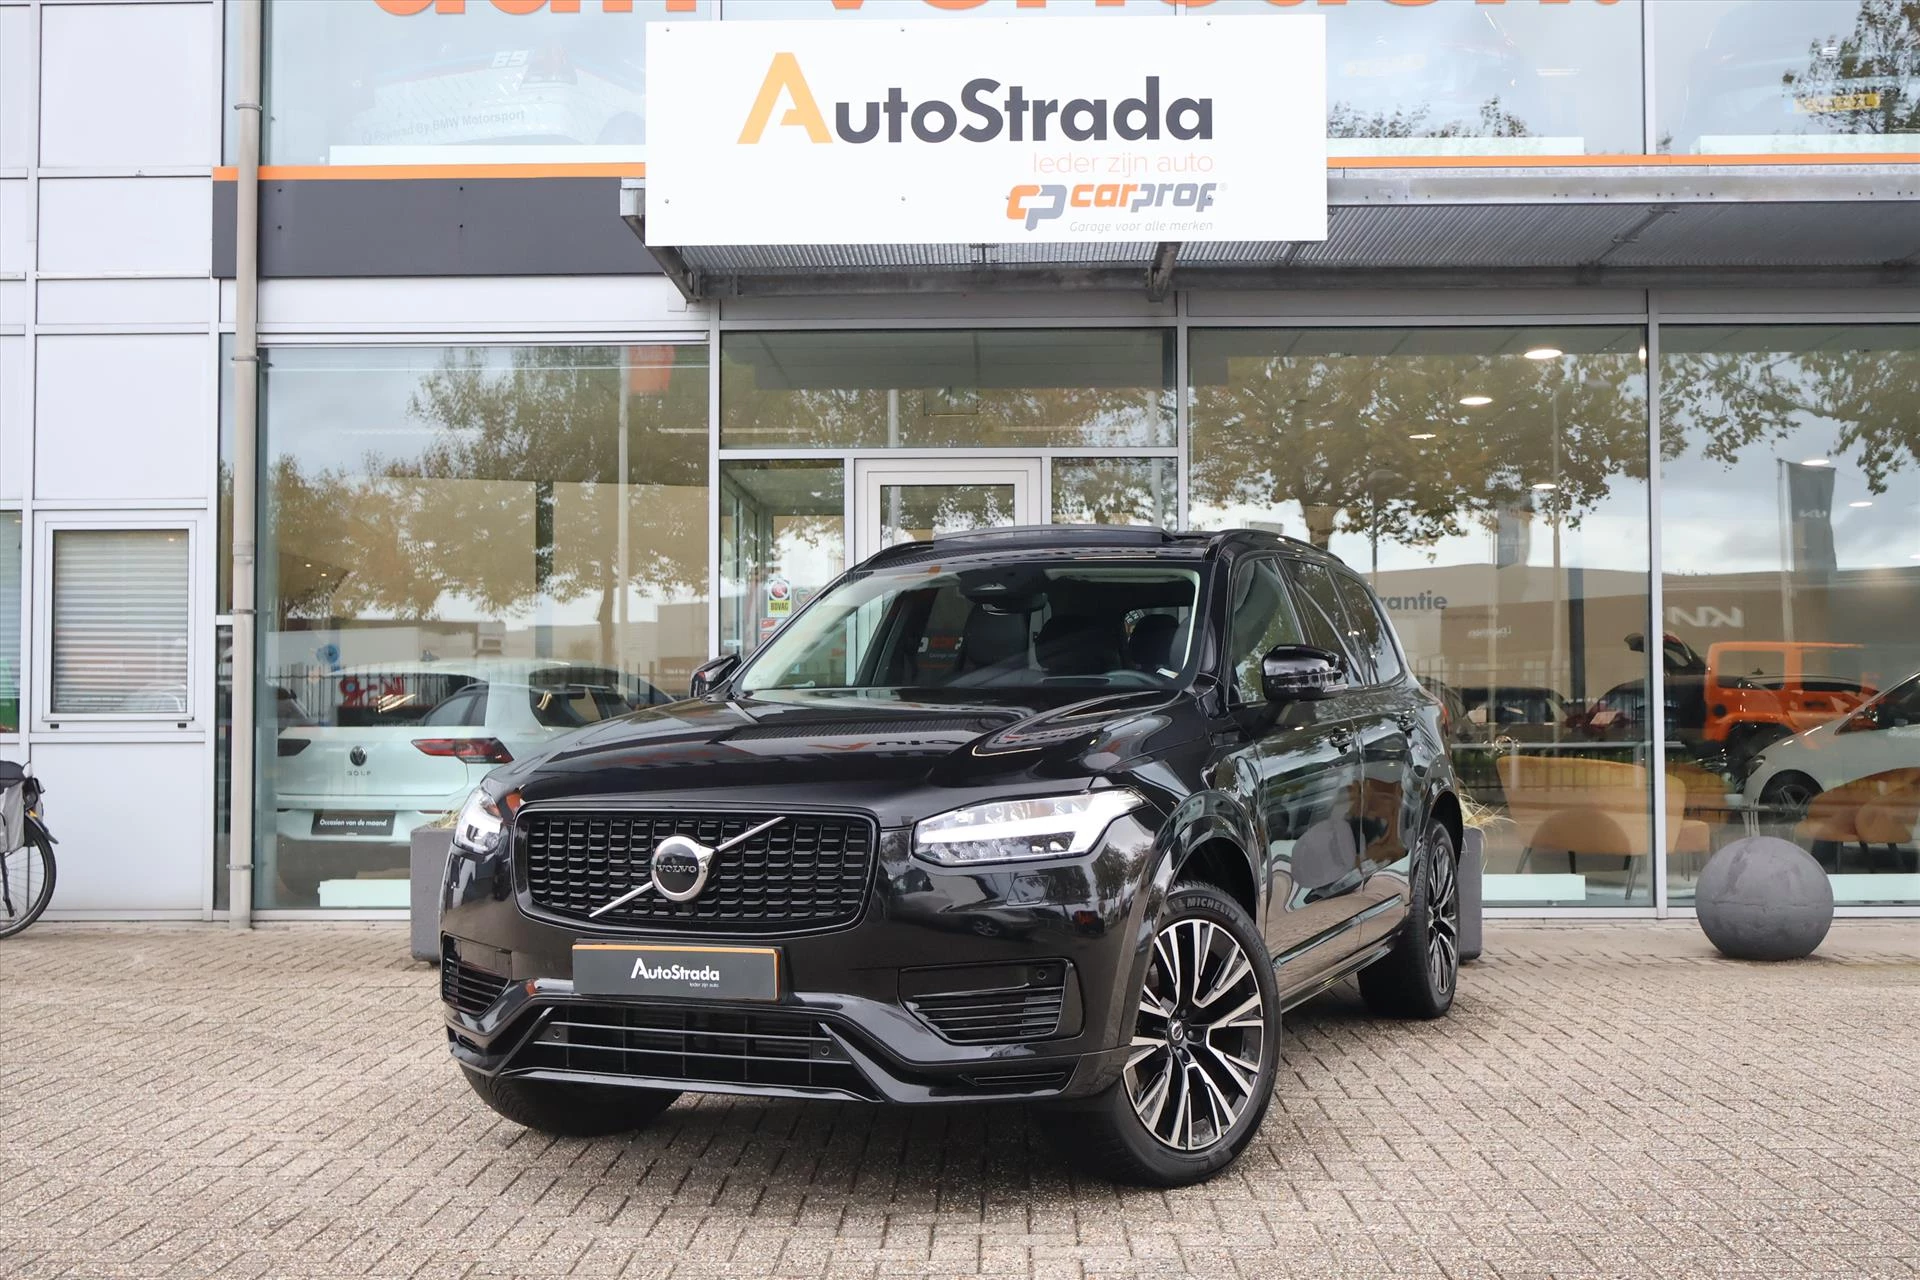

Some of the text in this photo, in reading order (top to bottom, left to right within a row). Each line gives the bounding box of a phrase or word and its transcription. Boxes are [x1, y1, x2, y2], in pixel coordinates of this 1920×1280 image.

[736, 52, 1213, 144] AutoStrada
[432, 118, 459, 130] BMW
[462, 110, 525, 126] Motorsport
[1033, 152, 1214, 177] Ieder zijn auto
[1069, 221, 1213, 234] Garage voor alle merken
[770, 602, 789, 611] BOVAG
[1380, 590, 1448, 611] rantie
[319, 818, 345, 826] Occasion
[357, 818, 365, 826] de
[656, 864, 697, 873] VOLVO
[1186, 897, 1238, 921] MICHELIN
[630, 957, 720, 981] AutoStrada
